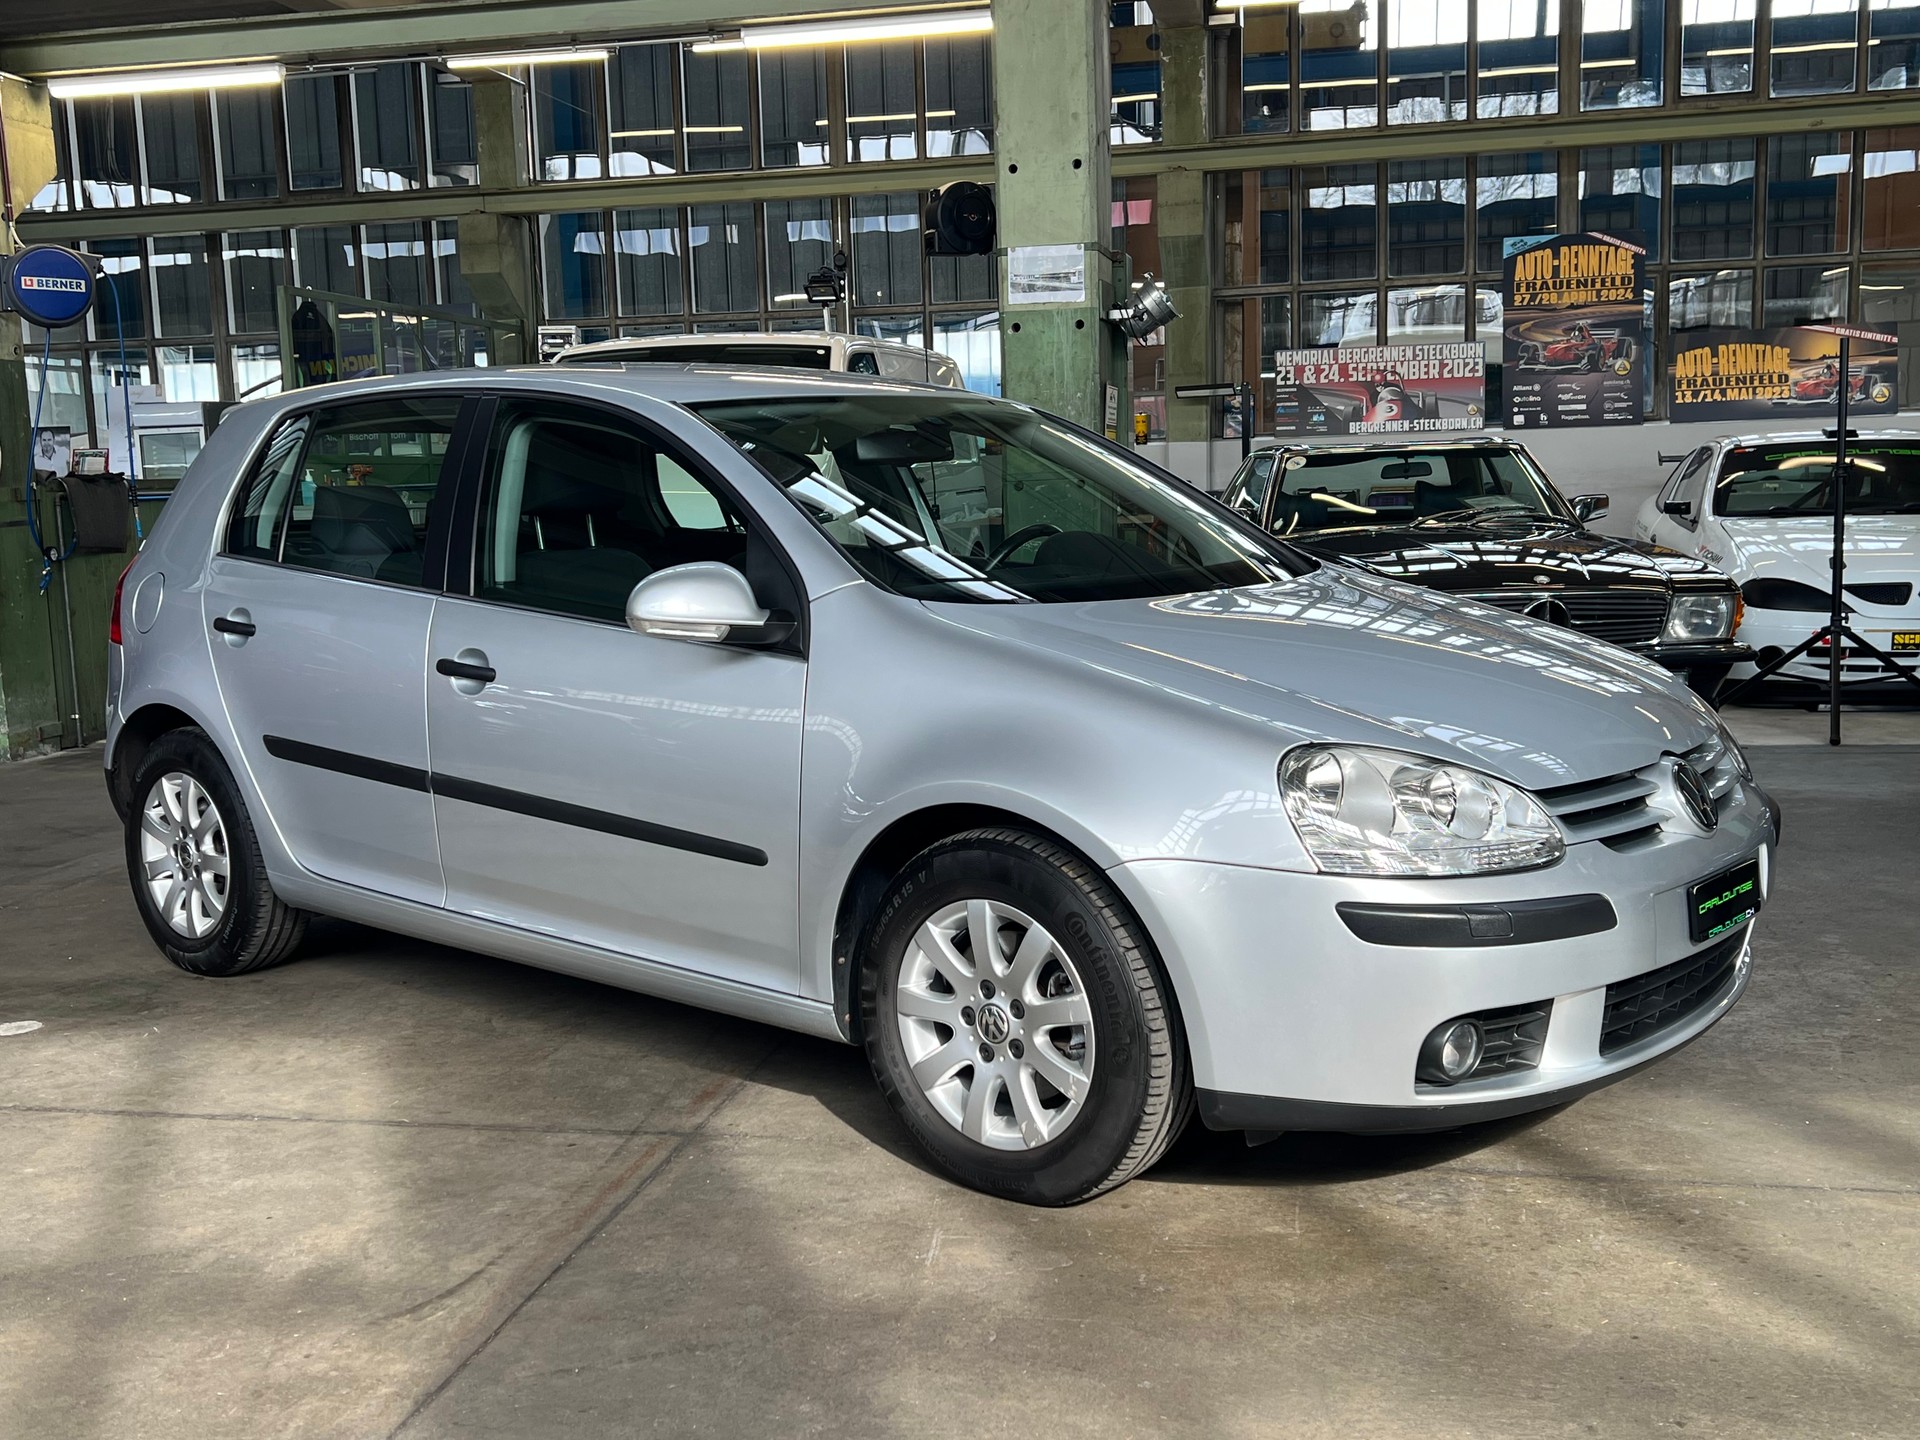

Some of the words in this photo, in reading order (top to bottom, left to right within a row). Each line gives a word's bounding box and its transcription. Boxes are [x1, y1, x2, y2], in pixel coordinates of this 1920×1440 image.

[1514, 244, 1635, 281] AUTO-RENNTAGE
[37, 278, 83, 291] BERNER
[1515, 275, 1633, 293] FRAUENFELD
[1600, 288, 1634, 301] 2024
[1835, 327, 1861, 338] GRATIS
[1861, 330, 1892, 343] EINTRITT
[1276, 348, 1336, 367] MEMORIAL
[1338, 345, 1413, 364] BERGRENNEN
[1415, 342, 1484, 361] STECKBORN
[1675, 343, 1791, 378] AUTO-RENNTAGE
[1276, 366, 1300, 386] 23.
[1303, 365, 1317, 384] &
[1320, 363, 1345, 383] 24.
[1348, 360, 1440, 382] SEPTEMBER
[1442, 358, 1484, 379] 2023
[1676, 374, 1790, 389] FRAUENFELD
[1756, 386, 1791, 400] 2023
[1349, 416, 1484, 434] BERGRENNEN-STECKBORN.CH
[901, 880, 914, 898] 15
